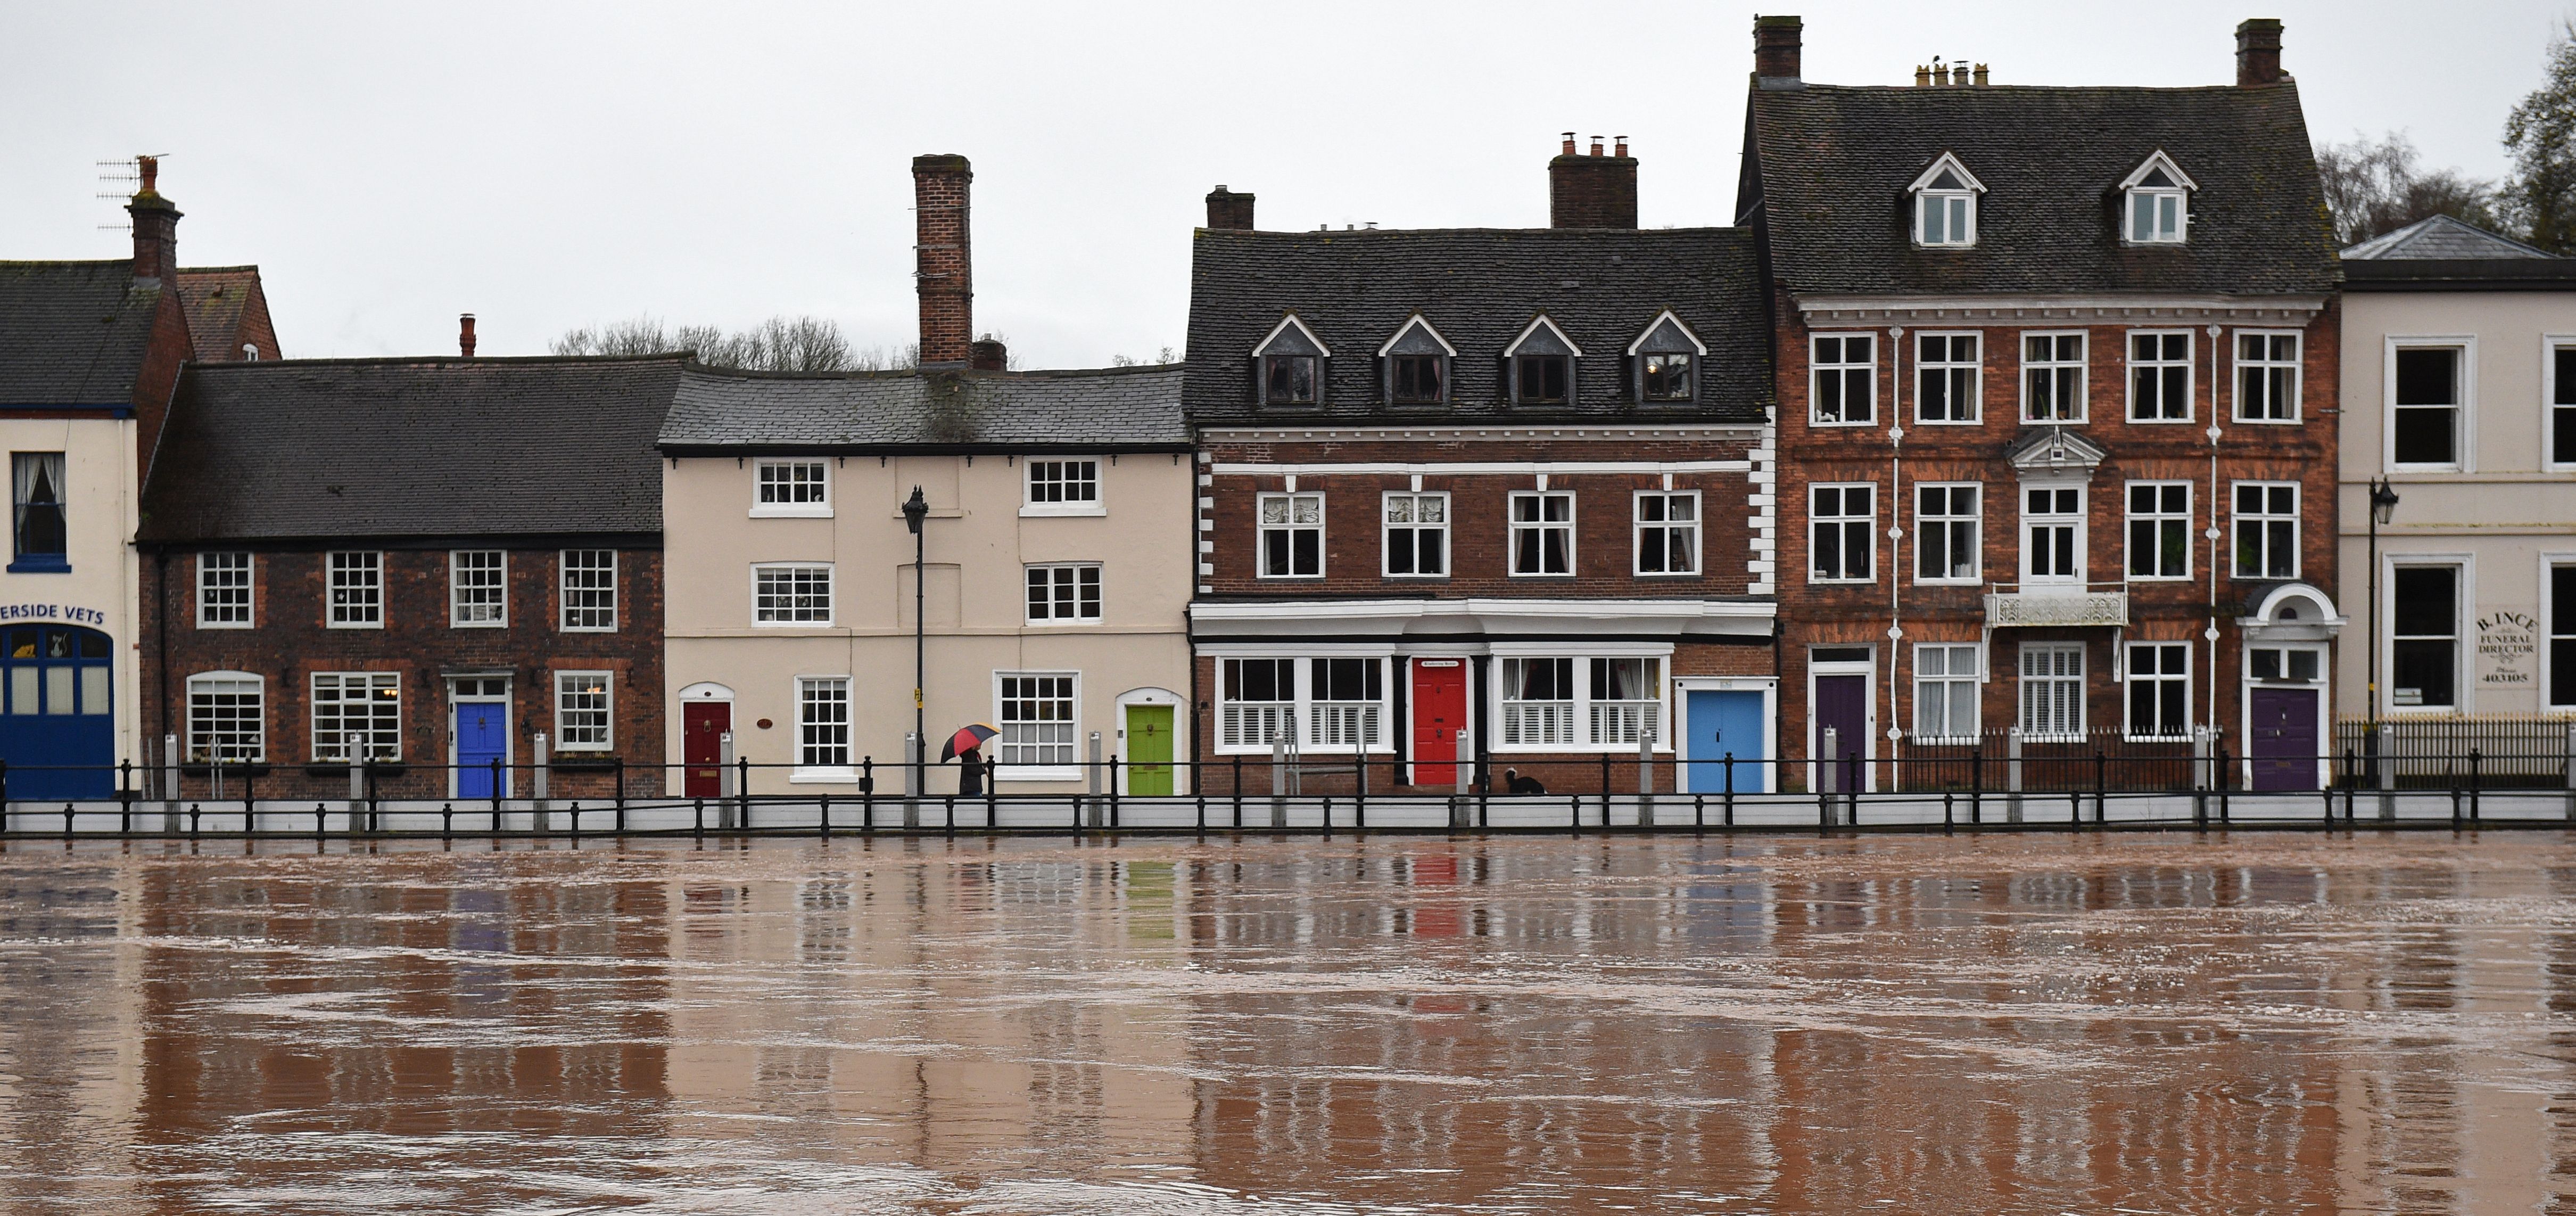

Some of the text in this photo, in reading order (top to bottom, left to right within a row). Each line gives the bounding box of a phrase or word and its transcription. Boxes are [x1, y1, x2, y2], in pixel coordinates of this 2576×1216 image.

[1, 604, 104, 625] ERSIDE VETS
[2477, 612, 2539, 633] B. INCE
[2480, 635, 2530, 644] FUNERAL
[2478, 645, 2534, 654] DIRECTOR
[2482, 673, 2529, 683] 403105
